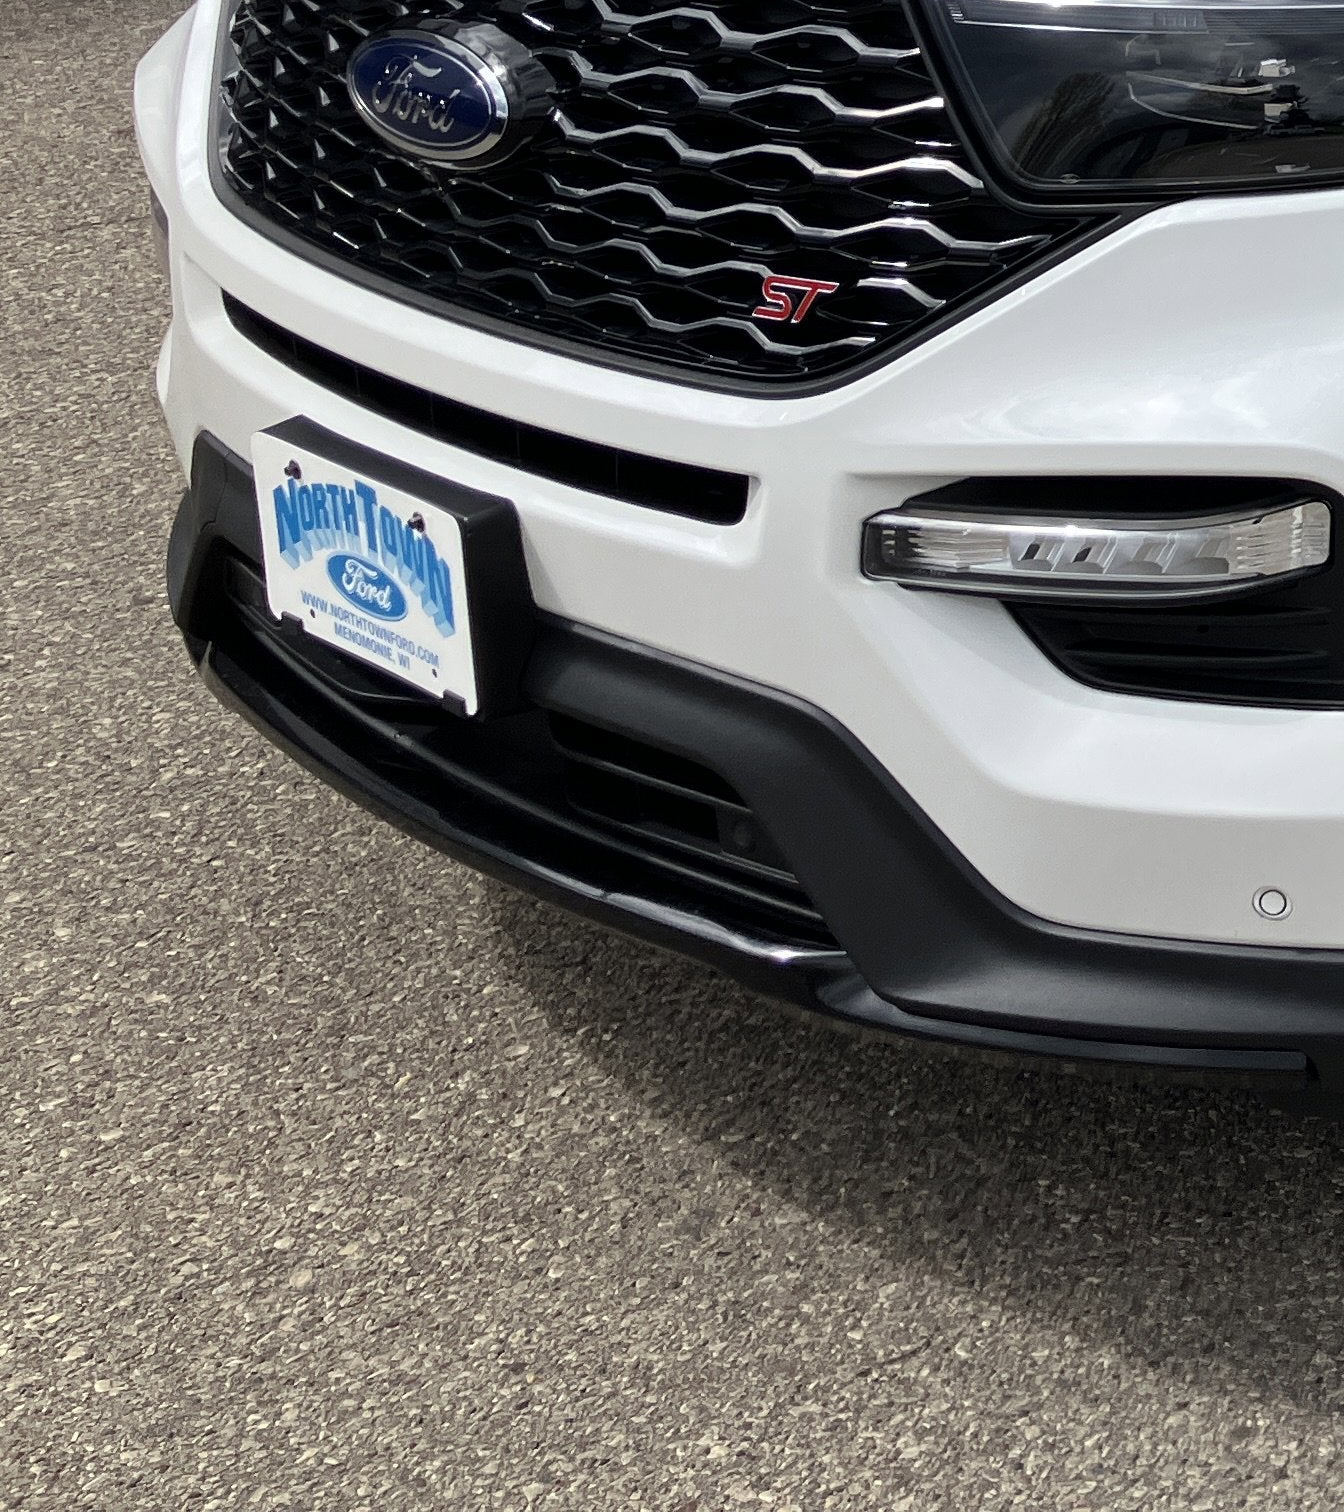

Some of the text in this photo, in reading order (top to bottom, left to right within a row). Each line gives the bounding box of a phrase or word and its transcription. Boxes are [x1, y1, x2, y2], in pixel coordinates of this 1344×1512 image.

[371, 54, 461, 134] Ford
[752, 275, 840, 323] ST
[273, 477, 456, 635] NORTHTOWN
[341, 558, 393, 612] Ford
[300, 590, 440, 669] WWW.NORTHTOWNFORD.COM
[397, 652, 411, 670] WI
